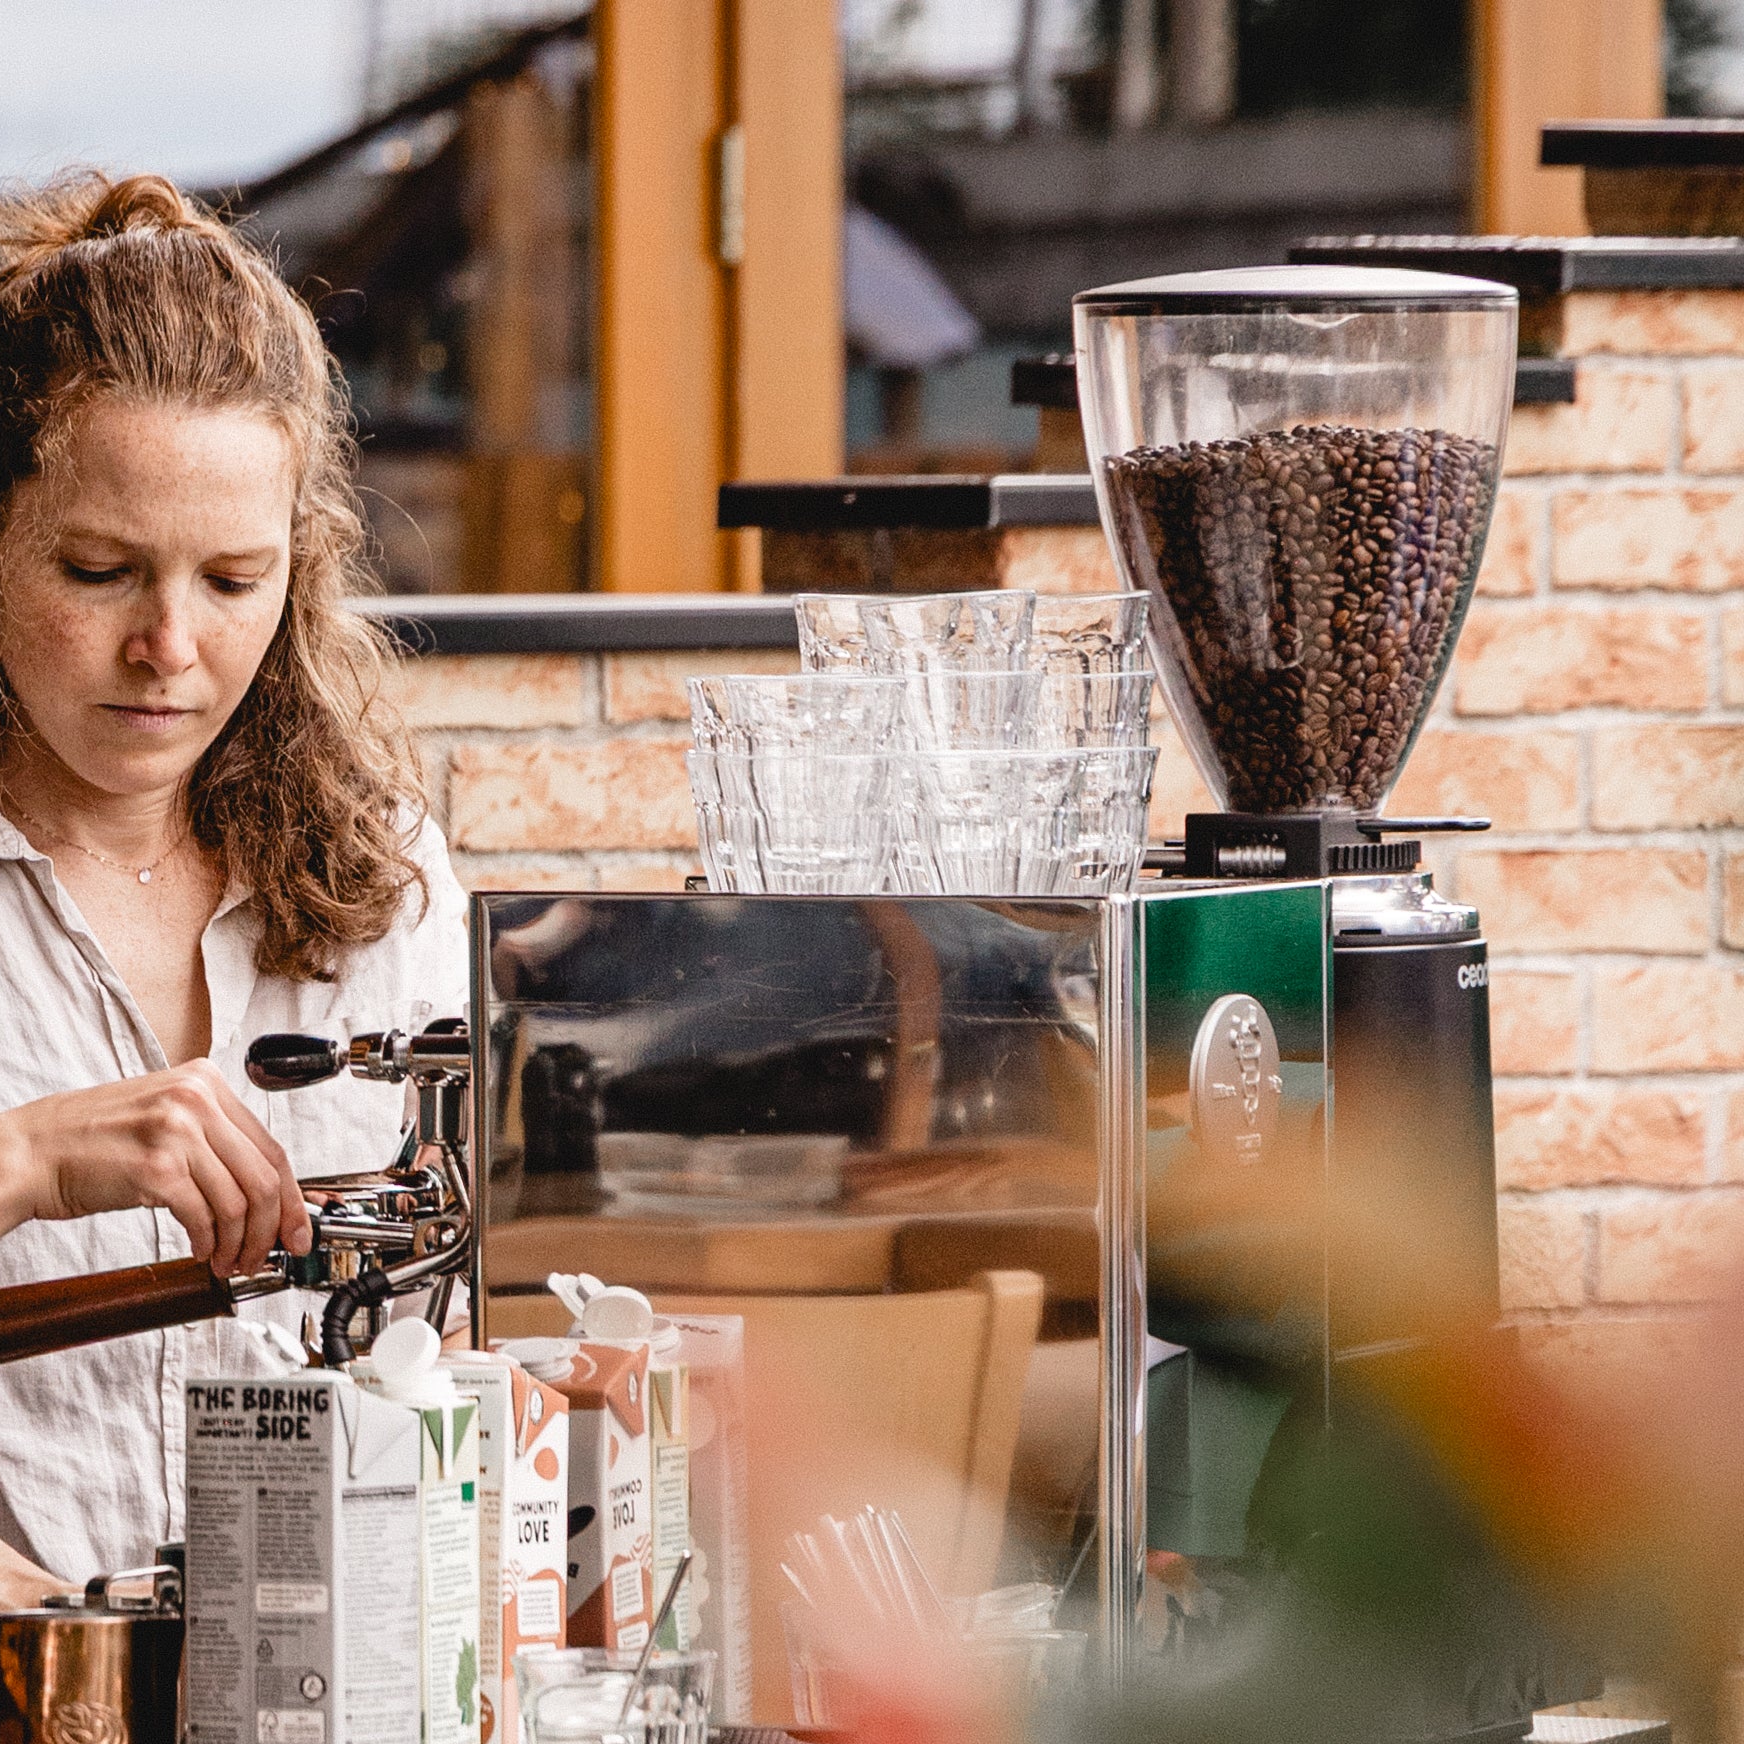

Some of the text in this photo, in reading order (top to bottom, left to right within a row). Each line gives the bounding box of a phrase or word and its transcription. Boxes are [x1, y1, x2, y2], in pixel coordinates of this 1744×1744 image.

[187, 1386, 329, 1415] THE BORING
[255, 1414, 311, 1441] SIDE
[512, 1500, 559, 1516] COMMUNITY
[517, 1519, 550, 1545] LOVE
